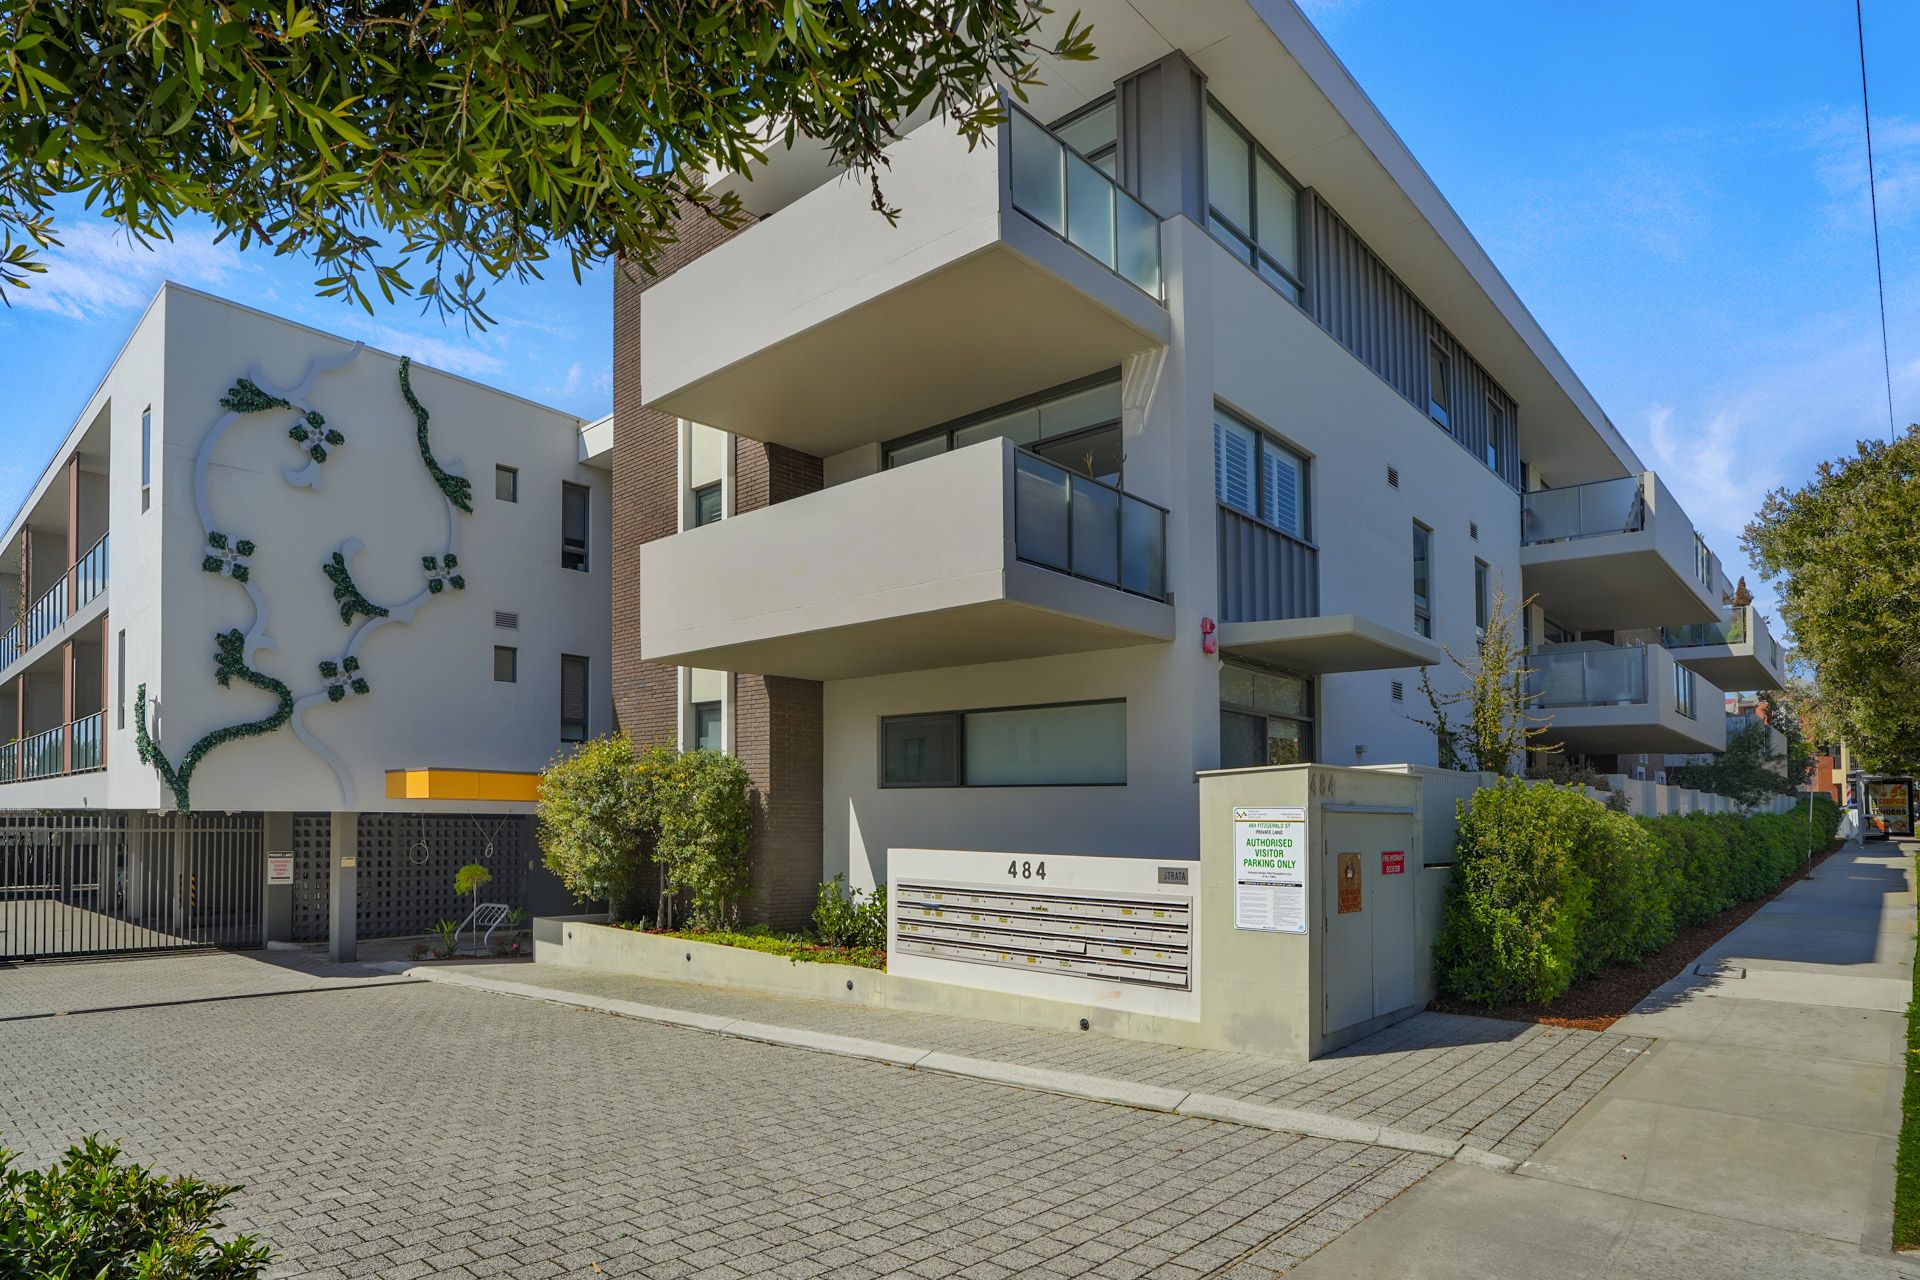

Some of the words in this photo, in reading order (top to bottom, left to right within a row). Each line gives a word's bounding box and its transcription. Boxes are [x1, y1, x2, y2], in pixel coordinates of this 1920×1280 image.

[1310, 773, 1335, 796] 484
[1246, 838, 1293, 848] AUTHORISED
[1255, 849, 1284, 858] VISITOR
[1243, 858, 1275, 868] PARKING
[1277, 859, 1296, 869] ONLY
[1008, 860, 1047, 880] 484
[1163, 871, 1186, 881] STRATA
